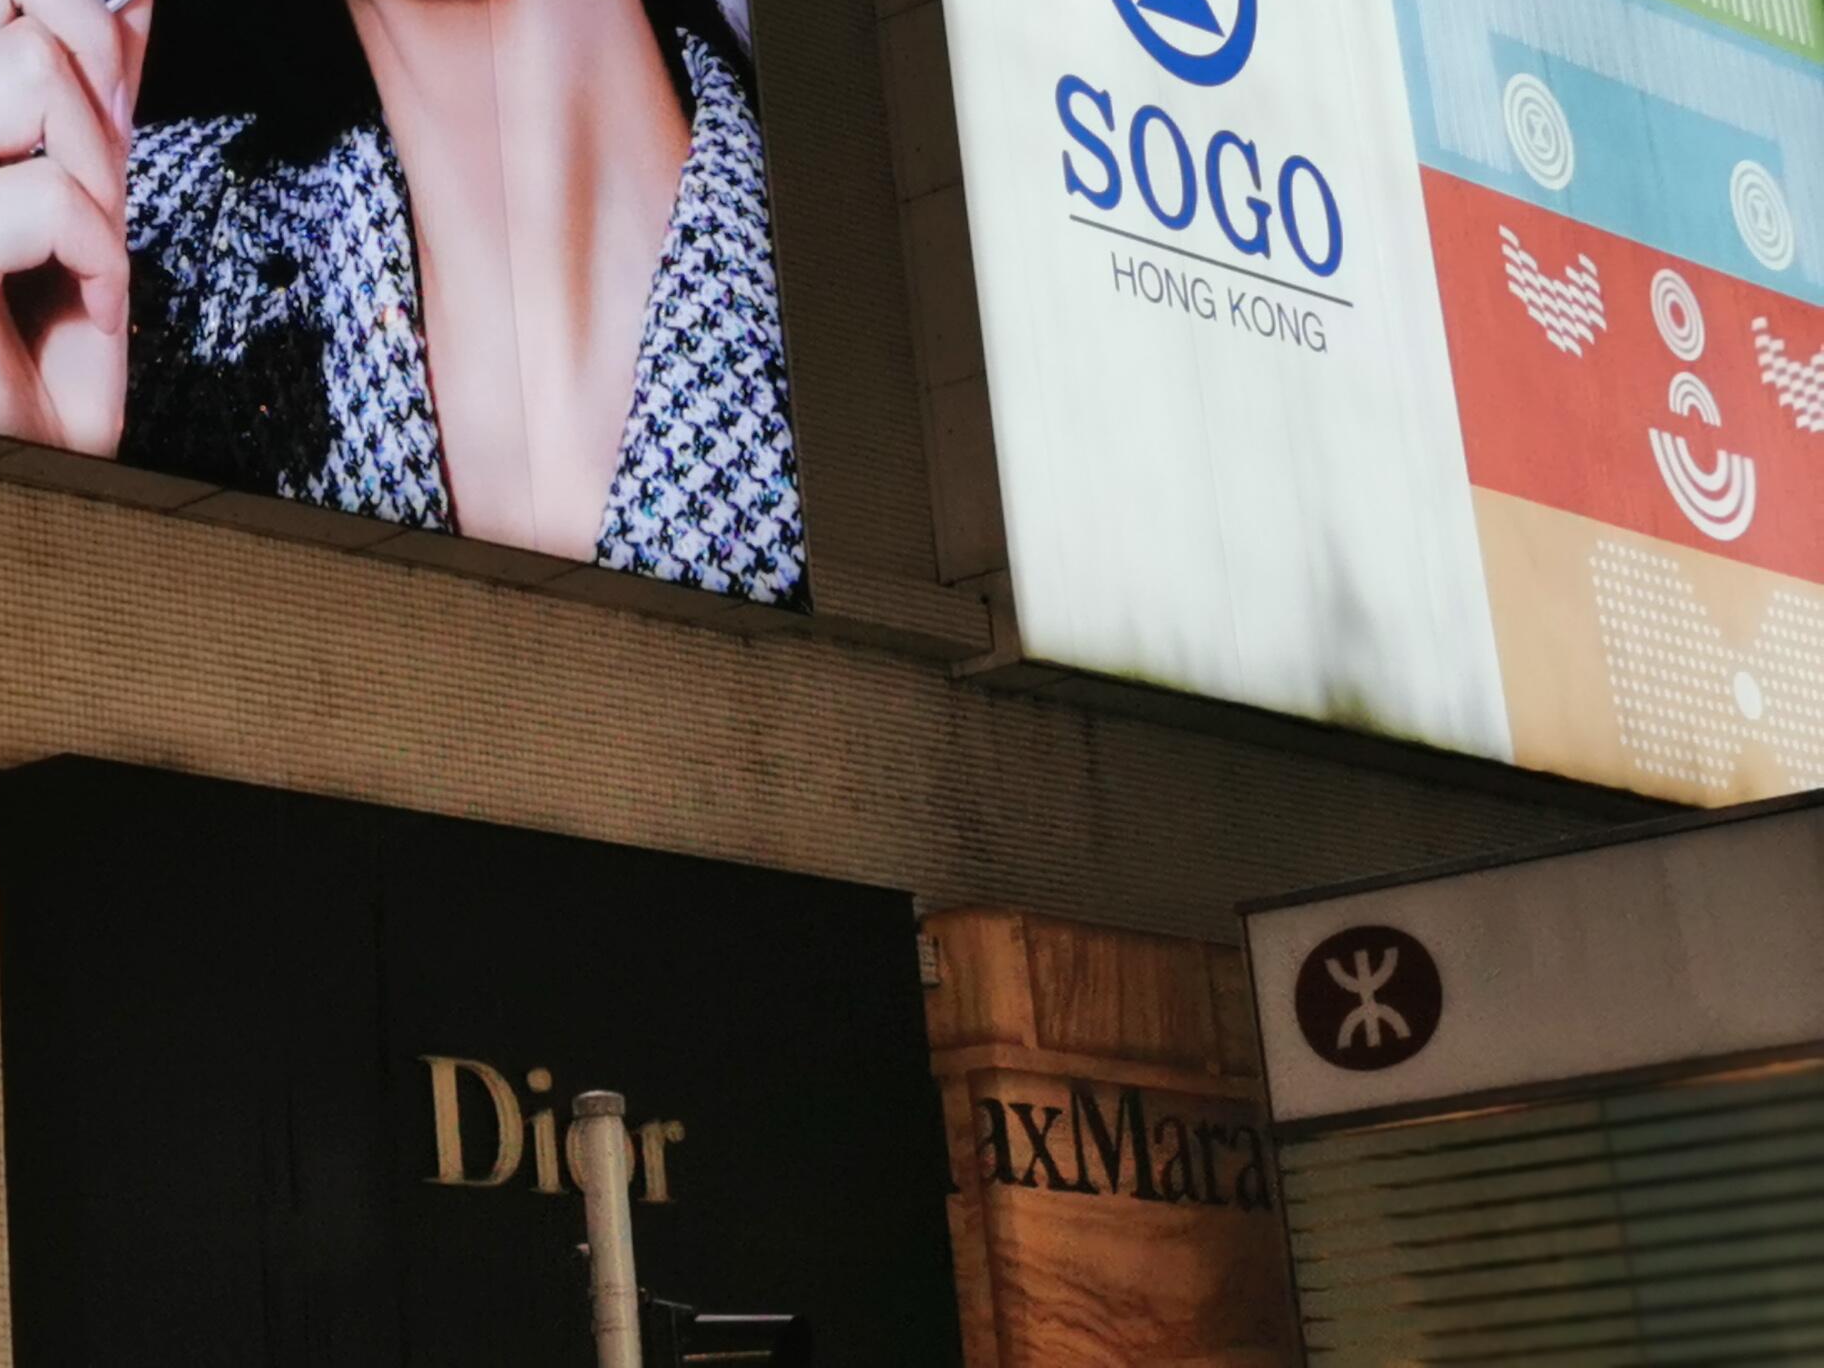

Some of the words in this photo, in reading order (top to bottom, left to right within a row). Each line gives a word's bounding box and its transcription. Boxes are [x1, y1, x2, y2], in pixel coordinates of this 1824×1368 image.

[1055, 73, 1344, 278] SOGO
[1110, 250, 1217, 322] HONG
[1227, 287, 1328, 353] KONG
[951, 1078, 1275, 1213] axMara
